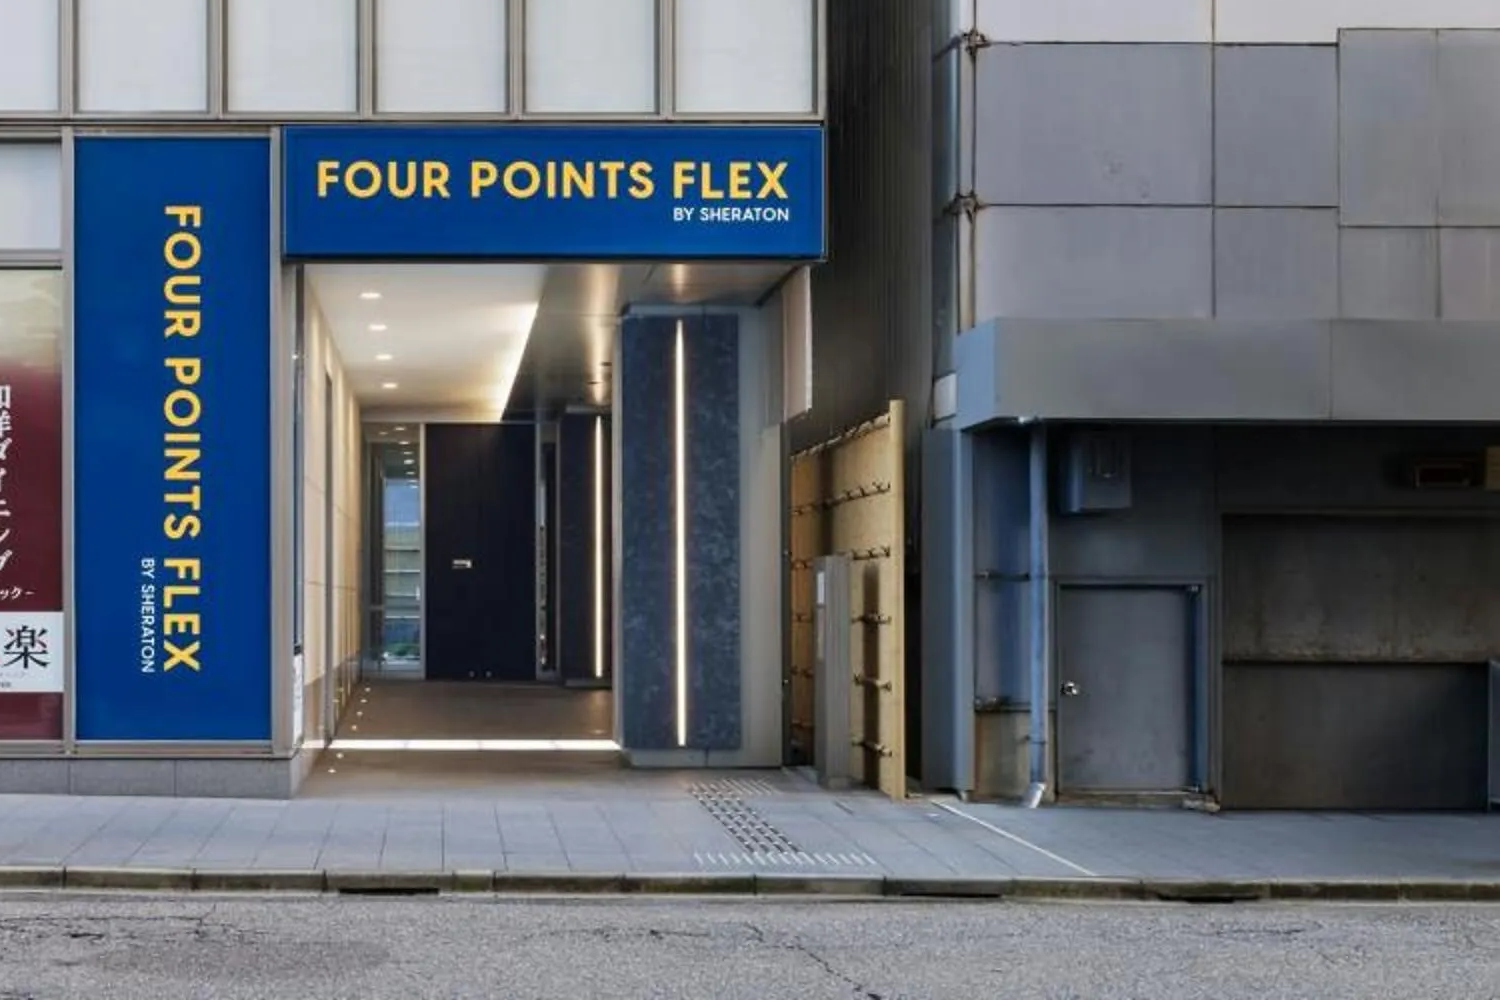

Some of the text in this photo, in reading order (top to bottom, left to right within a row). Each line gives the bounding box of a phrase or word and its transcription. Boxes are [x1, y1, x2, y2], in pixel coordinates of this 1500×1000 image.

[317, 160, 789, 200] FOUR POINTS FLEX
[673, 206, 790, 222] BY SHERATON
[162, 204, 202, 671] FOUR POINTS FLEX
[141, 558, 156, 674] BY SHERATON
